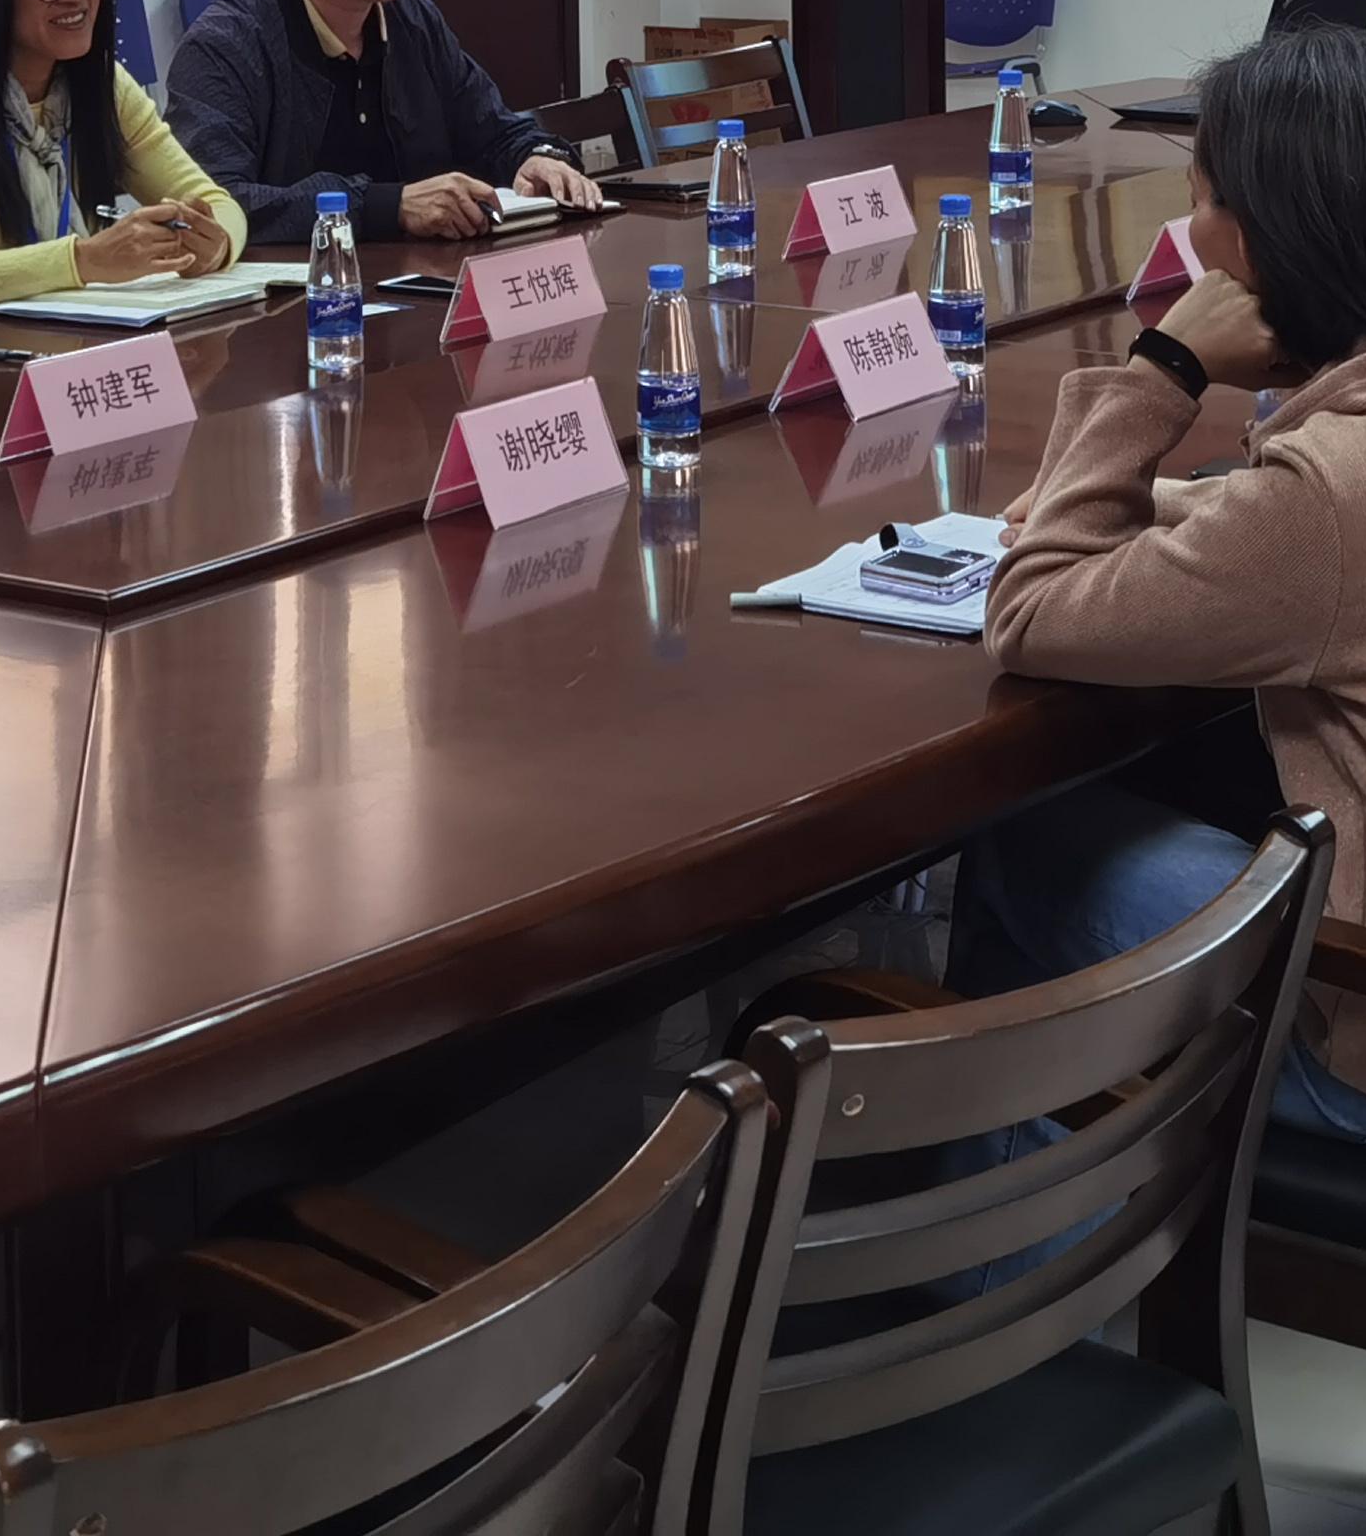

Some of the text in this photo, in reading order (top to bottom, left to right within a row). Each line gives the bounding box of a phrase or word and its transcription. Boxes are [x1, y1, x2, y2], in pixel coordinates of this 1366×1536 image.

[838, 188, 890, 227] 江波
[501, 262, 580, 310] 王悦辉
[843, 321, 919, 376] 陈静婉
[66, 364, 160, 420] 钟建军
[496, 411, 588, 472] 谢晓缨
